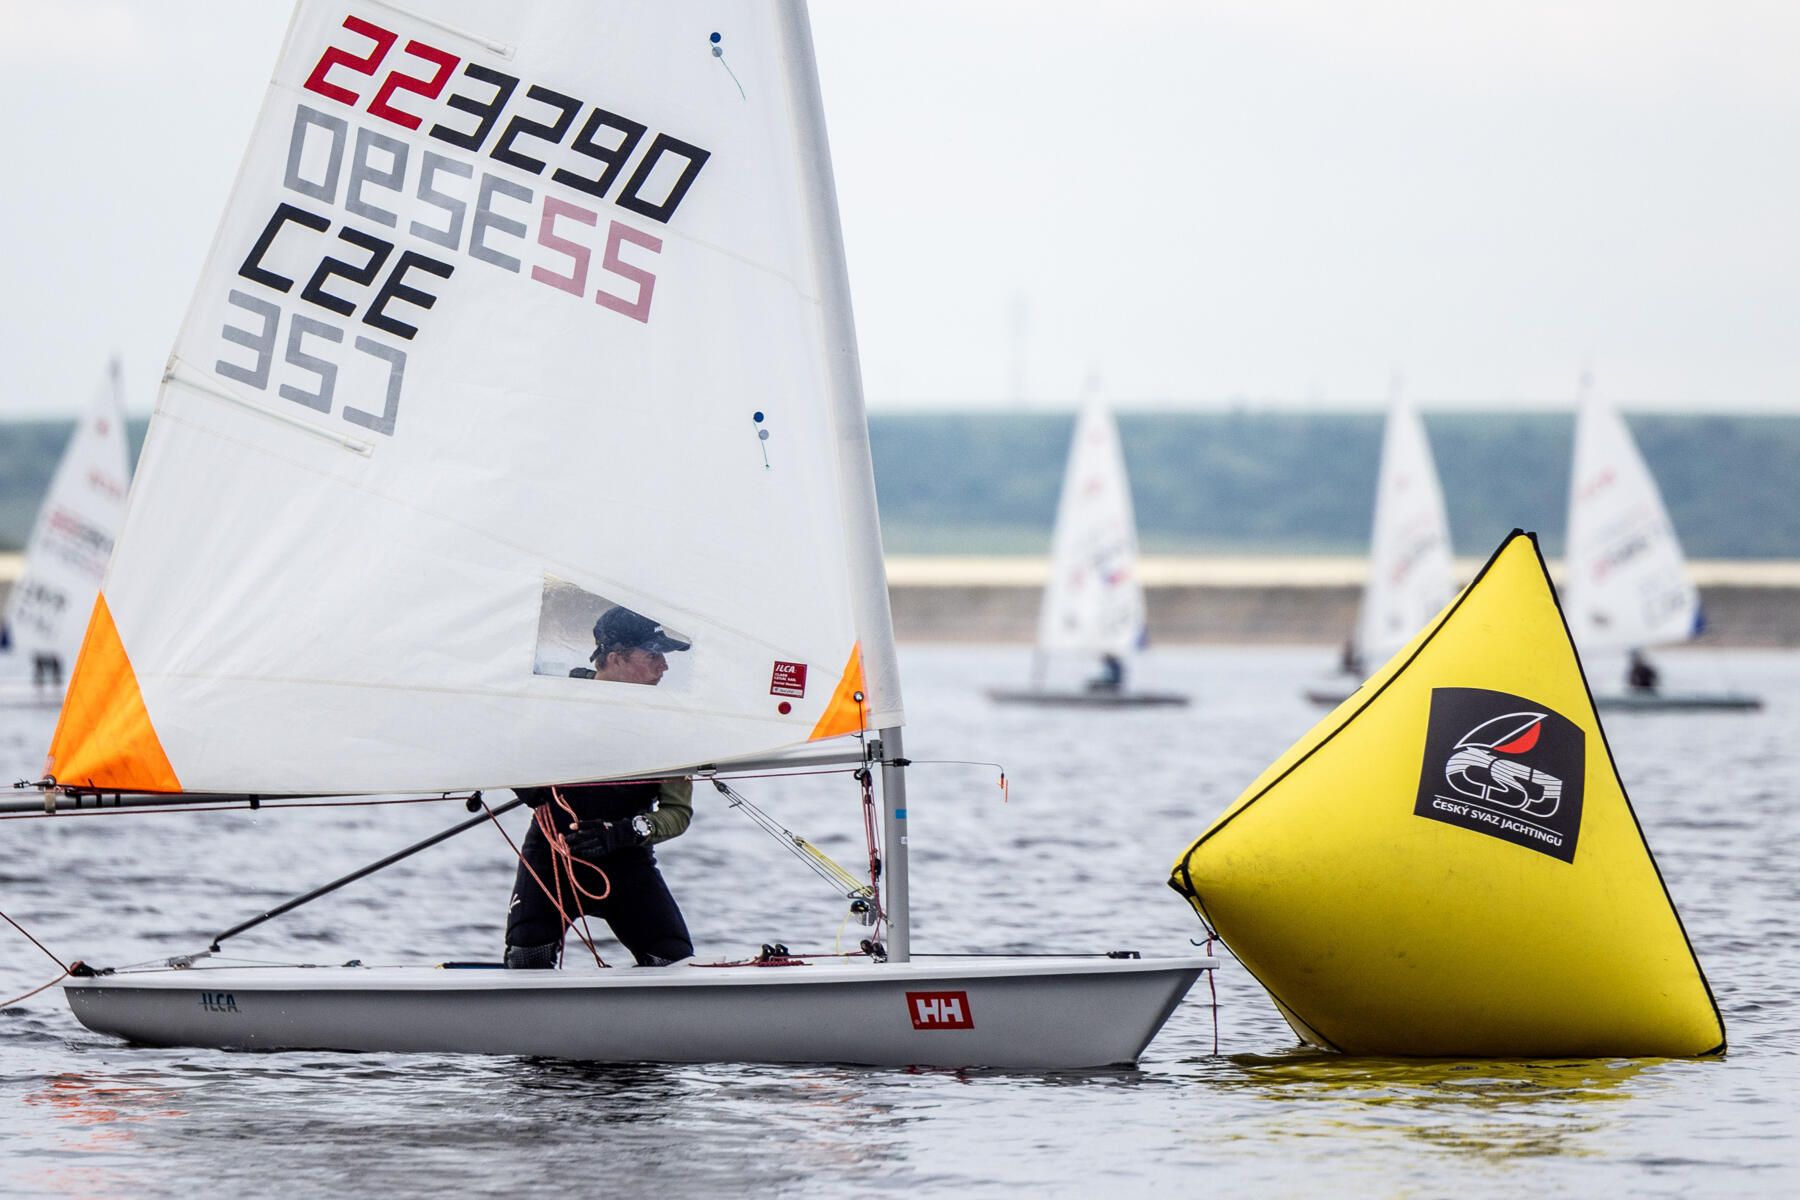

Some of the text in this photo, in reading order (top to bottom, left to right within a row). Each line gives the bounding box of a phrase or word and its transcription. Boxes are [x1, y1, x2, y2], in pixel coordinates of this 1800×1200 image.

[303, 15, 711, 224] 223290
[775, 664, 796, 673] ILCA
[1432, 799, 1563, 847] ČESKÝ SVAZ JACHTINGU
[201, 992, 239, 1012] ILCA
[916, 998, 964, 1023] HH
